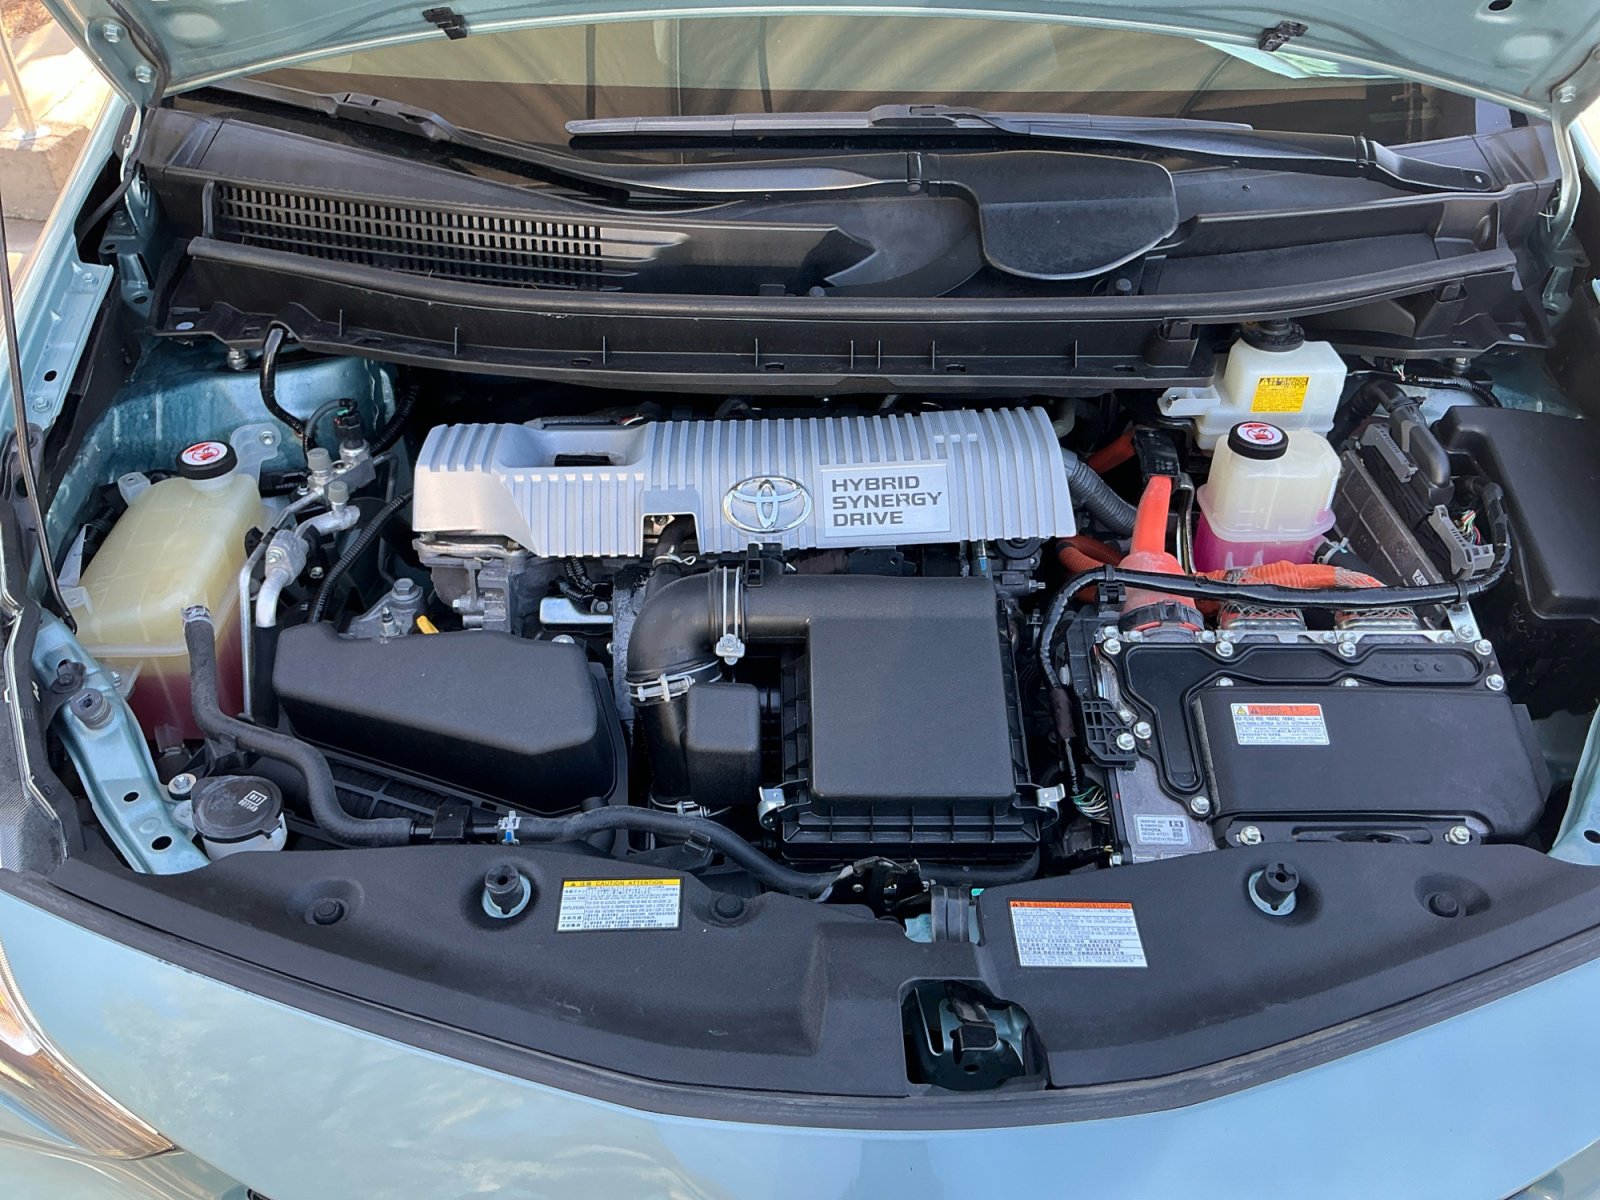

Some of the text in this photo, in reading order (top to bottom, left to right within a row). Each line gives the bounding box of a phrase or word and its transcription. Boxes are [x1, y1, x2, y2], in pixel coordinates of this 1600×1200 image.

[832, 475, 920, 492] HYBRID
[832, 492, 942, 510] SYNERGY
[833, 511, 903, 527] DRIVE
